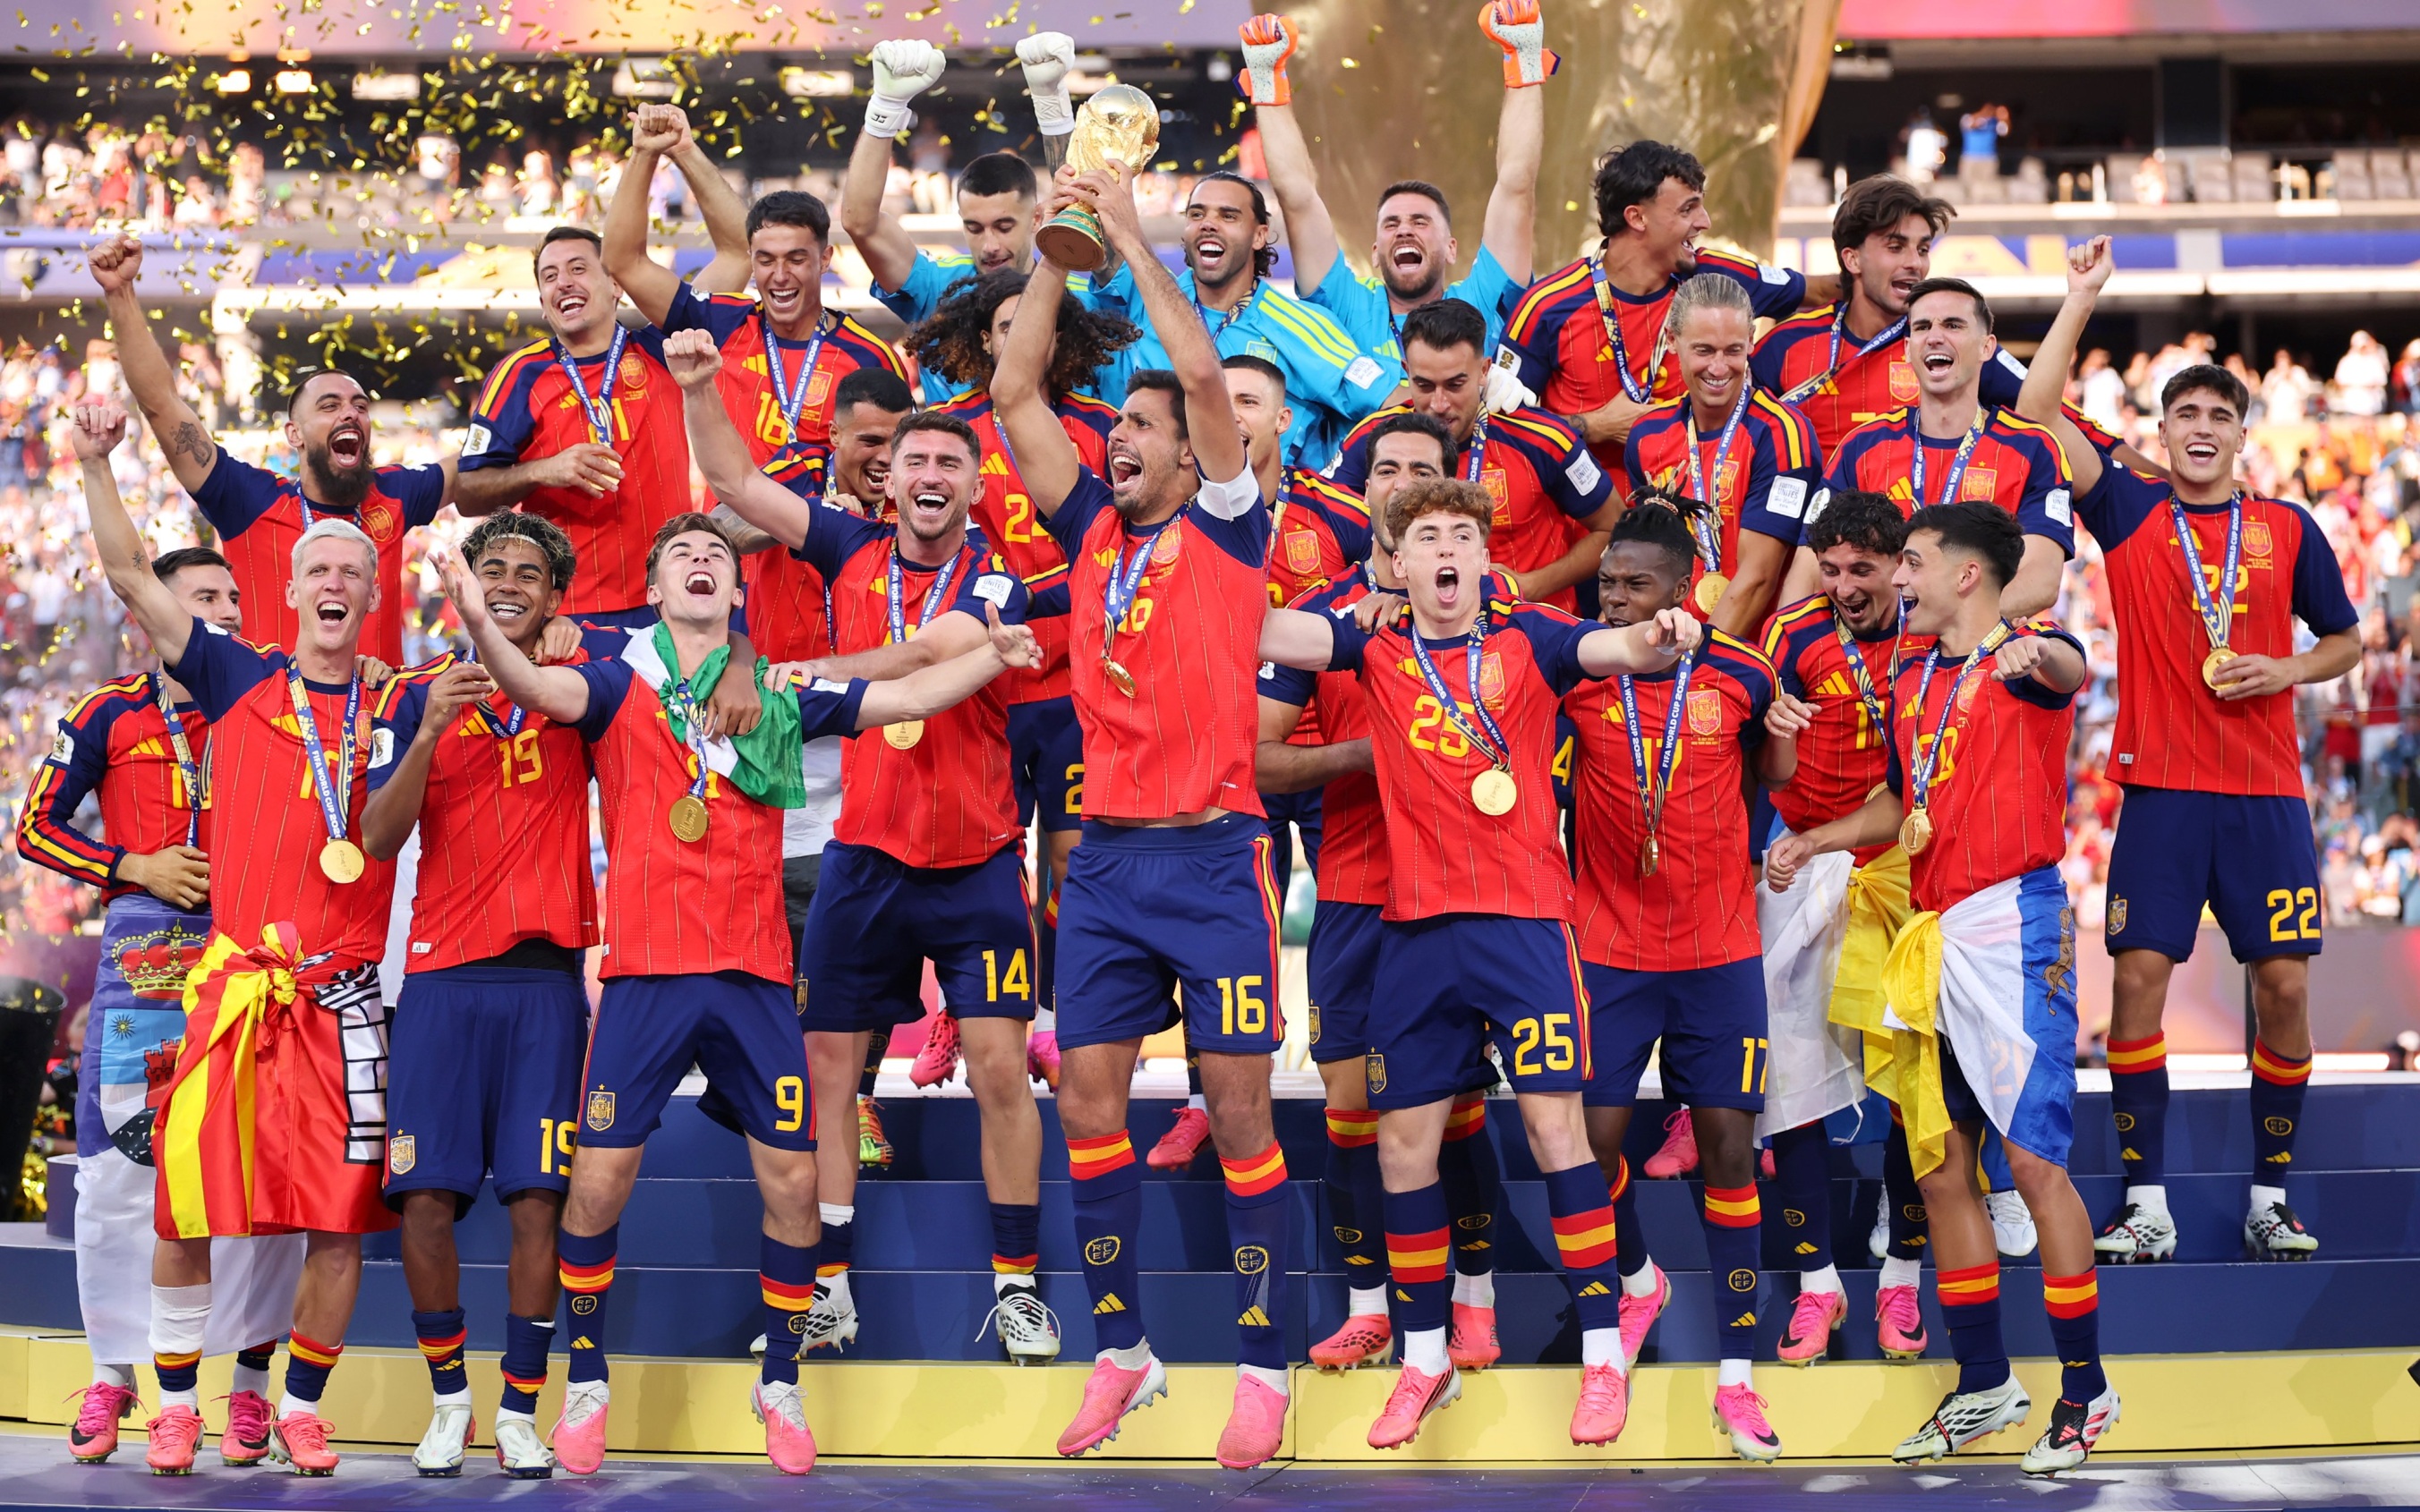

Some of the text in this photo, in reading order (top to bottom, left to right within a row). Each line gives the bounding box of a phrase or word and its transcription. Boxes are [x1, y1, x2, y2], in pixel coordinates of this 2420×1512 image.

[611, 345, 619, 359] CUP
[1879, 330, 1892, 342] CUP
[607, 359, 616, 382] WORLD
[768, 346, 778, 371] WORLD
[1616, 351, 1624, 367] FIFA
[1620, 367, 1635, 393] WORLD
[567, 364, 577, 378] FIFA
[574, 377, 586, 398] WORLD
[603, 382, 611, 395] FIFA
[774, 370, 782, 386] CUP
[777, 382, 788, 405] 2026
[789, 340, 819, 417] FIFA WORLD CUP 2026
[1721, 390, 1747, 447] FIFA WORLD CUP
[1470, 457, 1478, 482] 2026
[1913, 463, 1922, 489] 2026
[1943, 466, 1961, 505] FIFA WOR
[890, 564, 899, 583] FIFA
[1126, 542, 1151, 590] FIFA WORLD
[2177, 517, 2207, 599] FIFA WORLD CUP 2026
[2228, 546, 2236, 571] WORLD
[925, 588, 941, 616] WORLD
[936, 572, 947, 590] CUP
[984, 580, 1005, 591] UNITES
[1109, 579, 1118, 606] 2026
[2225, 571, 2233, 587] FIFA
[890, 583, 899, 612] WORLD
[892, 612, 900, 628] CUP
[1421, 658, 1433, 674] CUP
[1428, 672, 1447, 700] 2026
[1922, 667, 1931, 683] CUP
[347, 701, 356, 718] FIFA
[1470, 654, 1504, 746] FIFA WORLD CUP 2026
[1623, 688, 1635, 718] WORLD
[509, 720, 518, 734] CUP
[1409, 694, 1476, 759] 25
[1629, 718, 1639, 736] CUP
[1662, 672, 1687, 769] FIFA WORLD CUP 2026
[1922, 687, 1957, 782] FIFA WORLD CUP 2026
[498, 728, 542, 788] 19
[1551, 735, 1573, 786] 4
[1632, 737, 1643, 768] 2026
[311, 750, 321, 769] FIFA
[316, 768, 329, 798] WORLD
[325, 797, 335, 815] CUP
[2267, 887, 2322, 941] 22
[982, 948, 1030, 1002] 14
[1216, 975, 1265, 1035] 16
[1512, 1014, 1574, 1076] 25
[775, 1075, 804, 1132] 9
[541, 1118, 577, 1177] 19
